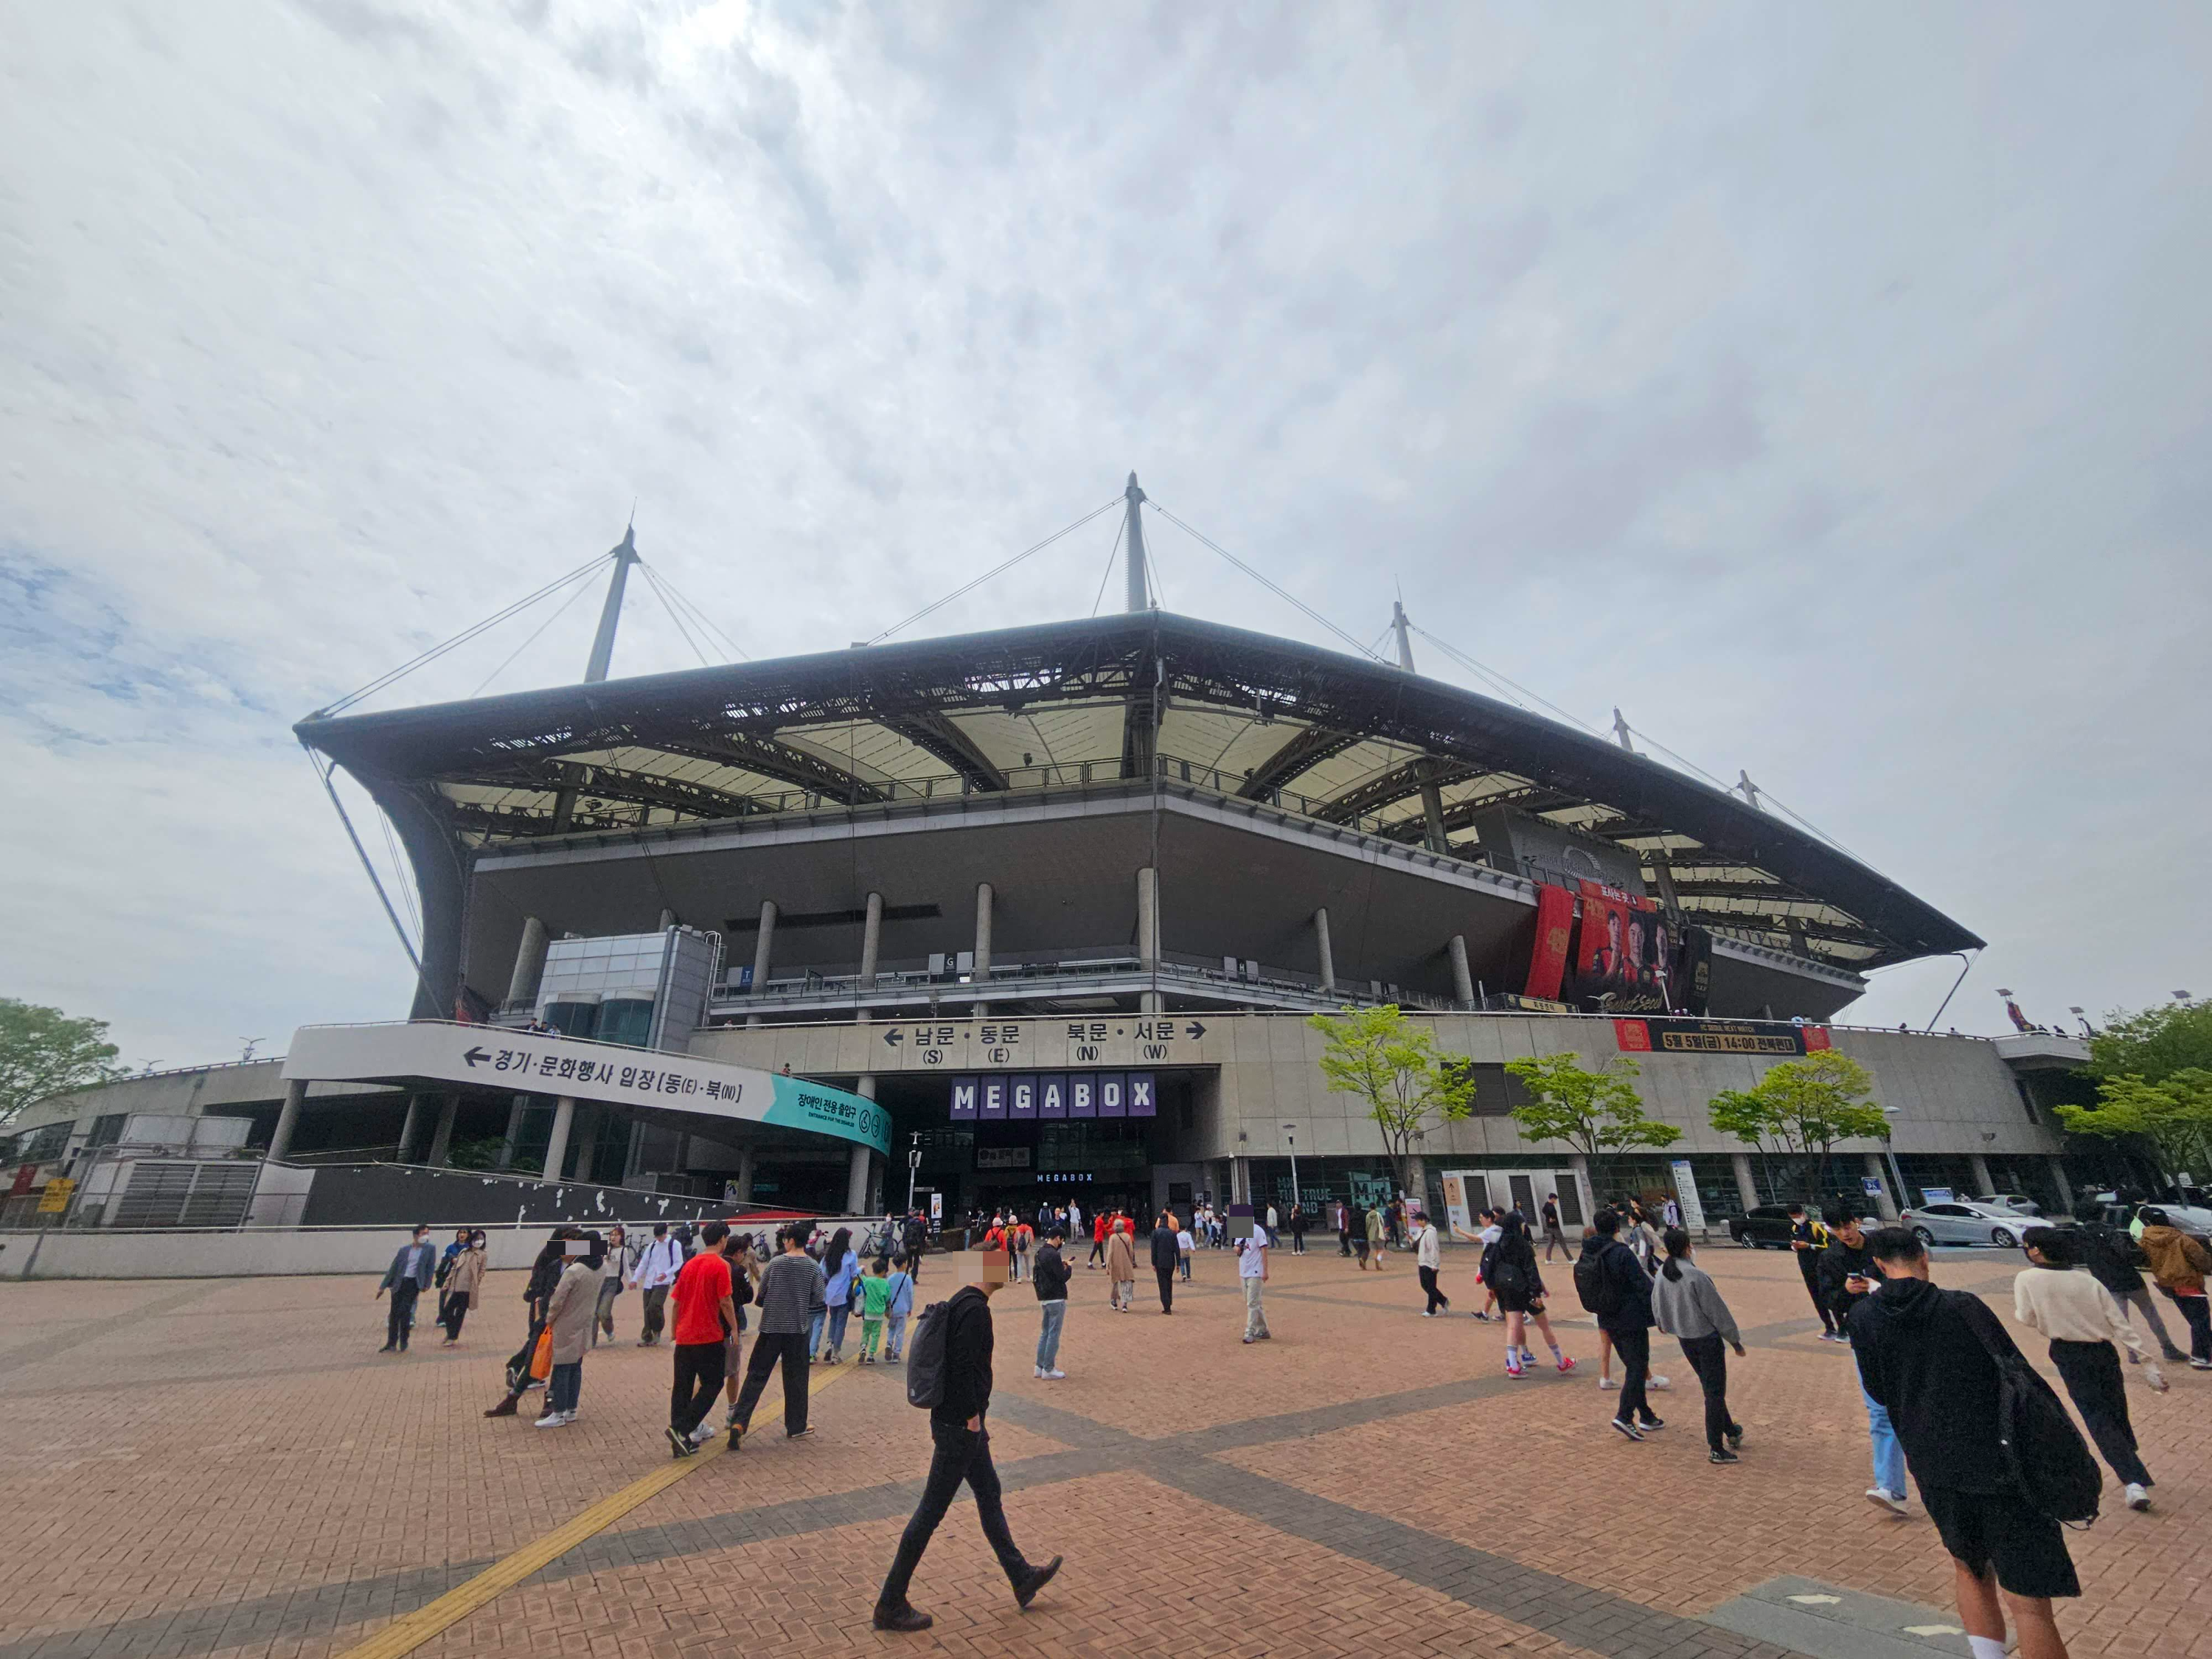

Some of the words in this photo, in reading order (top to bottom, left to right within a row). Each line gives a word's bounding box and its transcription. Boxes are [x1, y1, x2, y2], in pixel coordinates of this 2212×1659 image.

[947, 957, 954, 966] G
[915, 1026, 954, 1046] 남문
[980, 1026, 1020, 1045] 동문
[1067, 1023, 1107, 1043] 북문
[1134, 1021, 1175, 1041] 서문
[1665, 1034, 1683, 1048] 5월
[1686, 1035, 1721, 1049] 5일(금)
[1725, 1037, 1755, 1050] 14:00
[922, 1049, 943, 1065] (S)
[988, 1048, 1010, 1063] (E)
[1077, 1046, 1099, 1061] (N)
[1143, 1044, 1167, 1060] (W)
[955, 1082, 1150, 1110] MEGABOX
[798, 1093, 822, 1110] 장애인
[823, 1099, 838, 1114] 전용
[838, 1102, 857, 1119] 출입구
[1037, 1173, 1092, 1182] MEGABOX
[1301, 1188, 1332, 1201] TRUE
